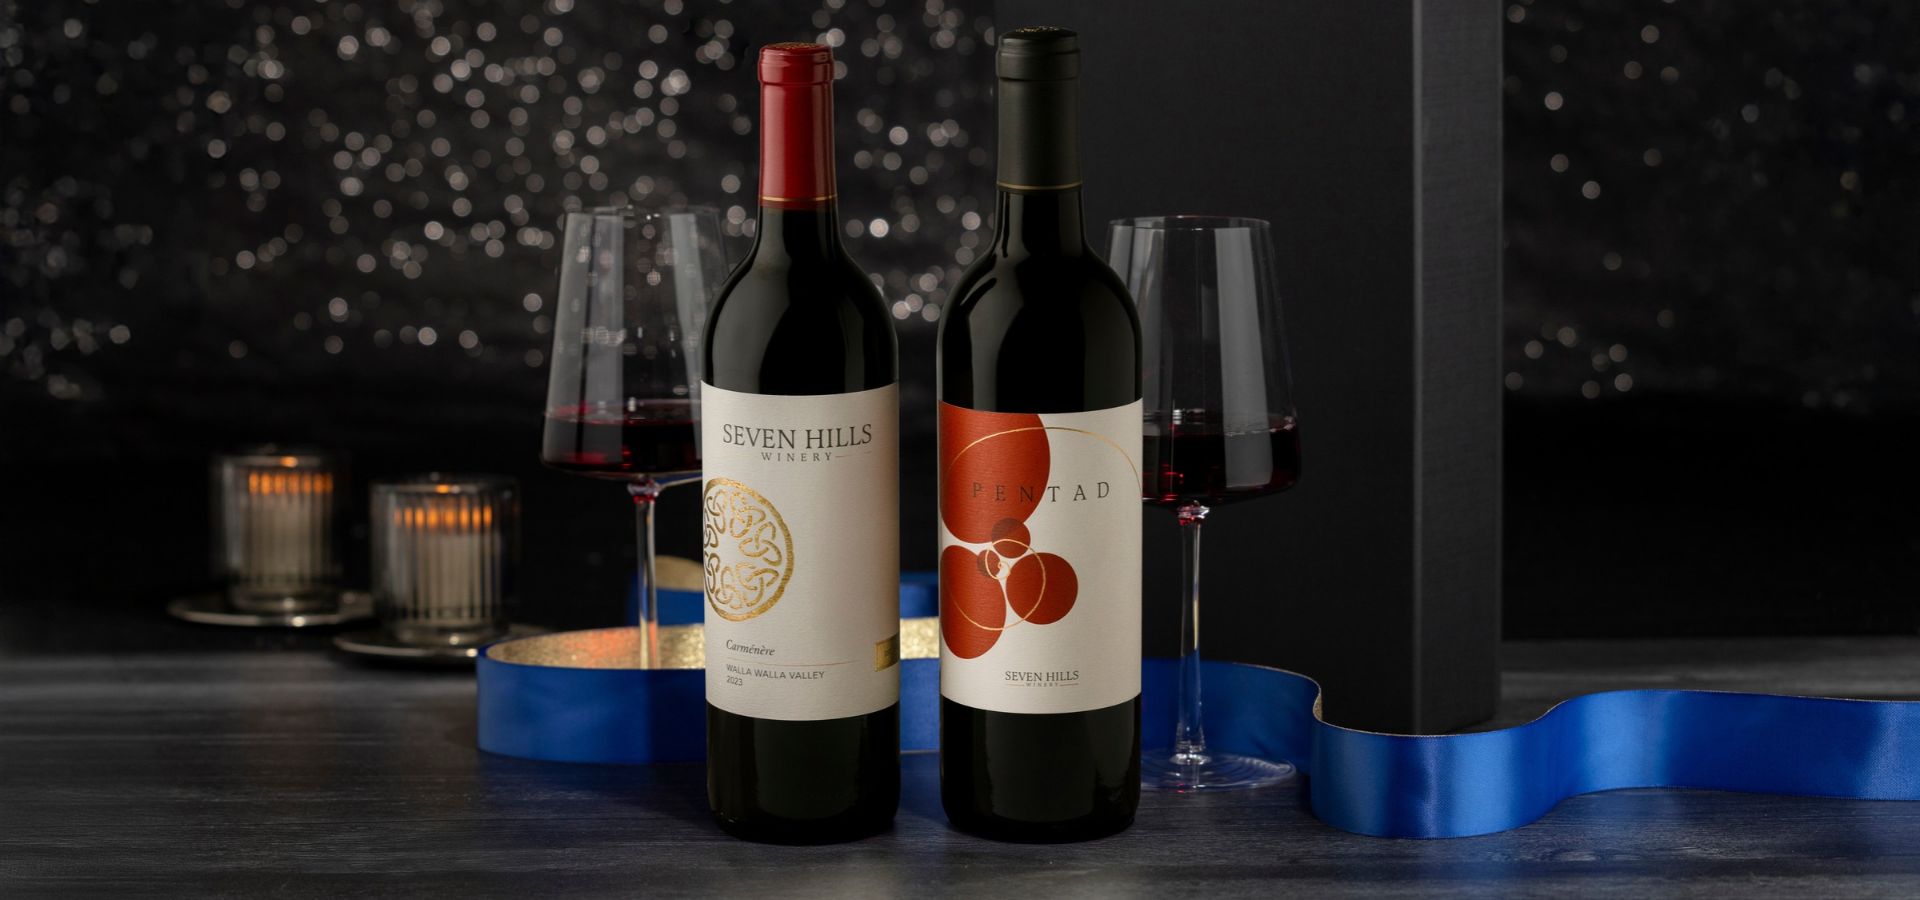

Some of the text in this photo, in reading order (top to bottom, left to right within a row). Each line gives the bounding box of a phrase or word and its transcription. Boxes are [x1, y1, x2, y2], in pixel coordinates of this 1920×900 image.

[723, 423, 872, 449] SEVEN HILLS
[761, 451, 833, 462] WINERY
[972, 481, 1110, 502] PENTAD
[726, 639, 776, 656] Carménère
[726, 663, 825, 680] WALLA WALLA VALLEY
[1005, 670, 1079, 682] SEVEN HILLS
[726, 675, 743, 687] 2023
